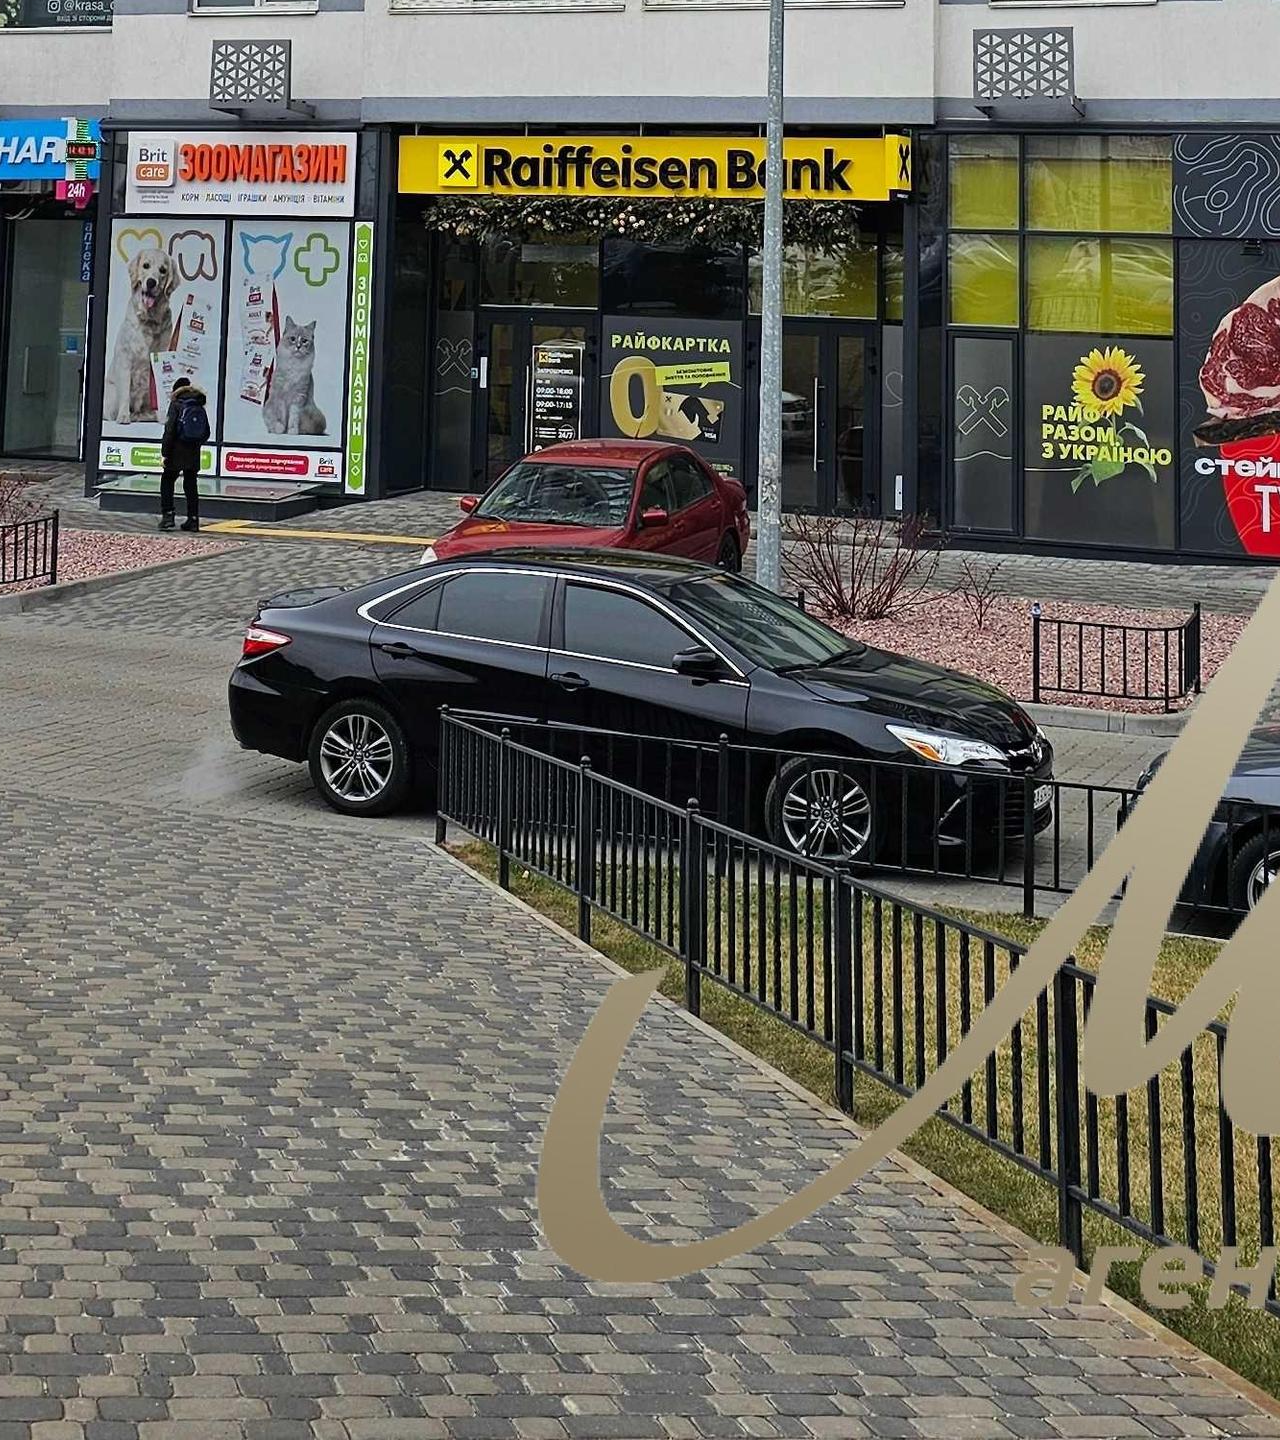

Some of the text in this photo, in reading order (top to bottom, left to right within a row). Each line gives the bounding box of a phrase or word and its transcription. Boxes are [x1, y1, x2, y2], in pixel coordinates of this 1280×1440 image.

[138, 147, 168, 163] Brit
[178, 143, 348, 184] ЗООМАГАЗИН
[139, 168, 166, 179] care
[482, 143, 718, 190] Raiffeisen
[67, 182, 86, 198] 24h
[181, 193, 200, 202] КОРМ
[205, 193, 233, 203] ЛАСОЩІ
[81, 221, 93, 282] аптека
[610, 331, 732, 353] РАЙФКАРТКА
[352, 275, 367, 437] ЗООМАГАЗИН
[1041, 403, 1101, 424] РАЙФ
[1041, 442, 1172, 466] З УКРАЇНОЮ
